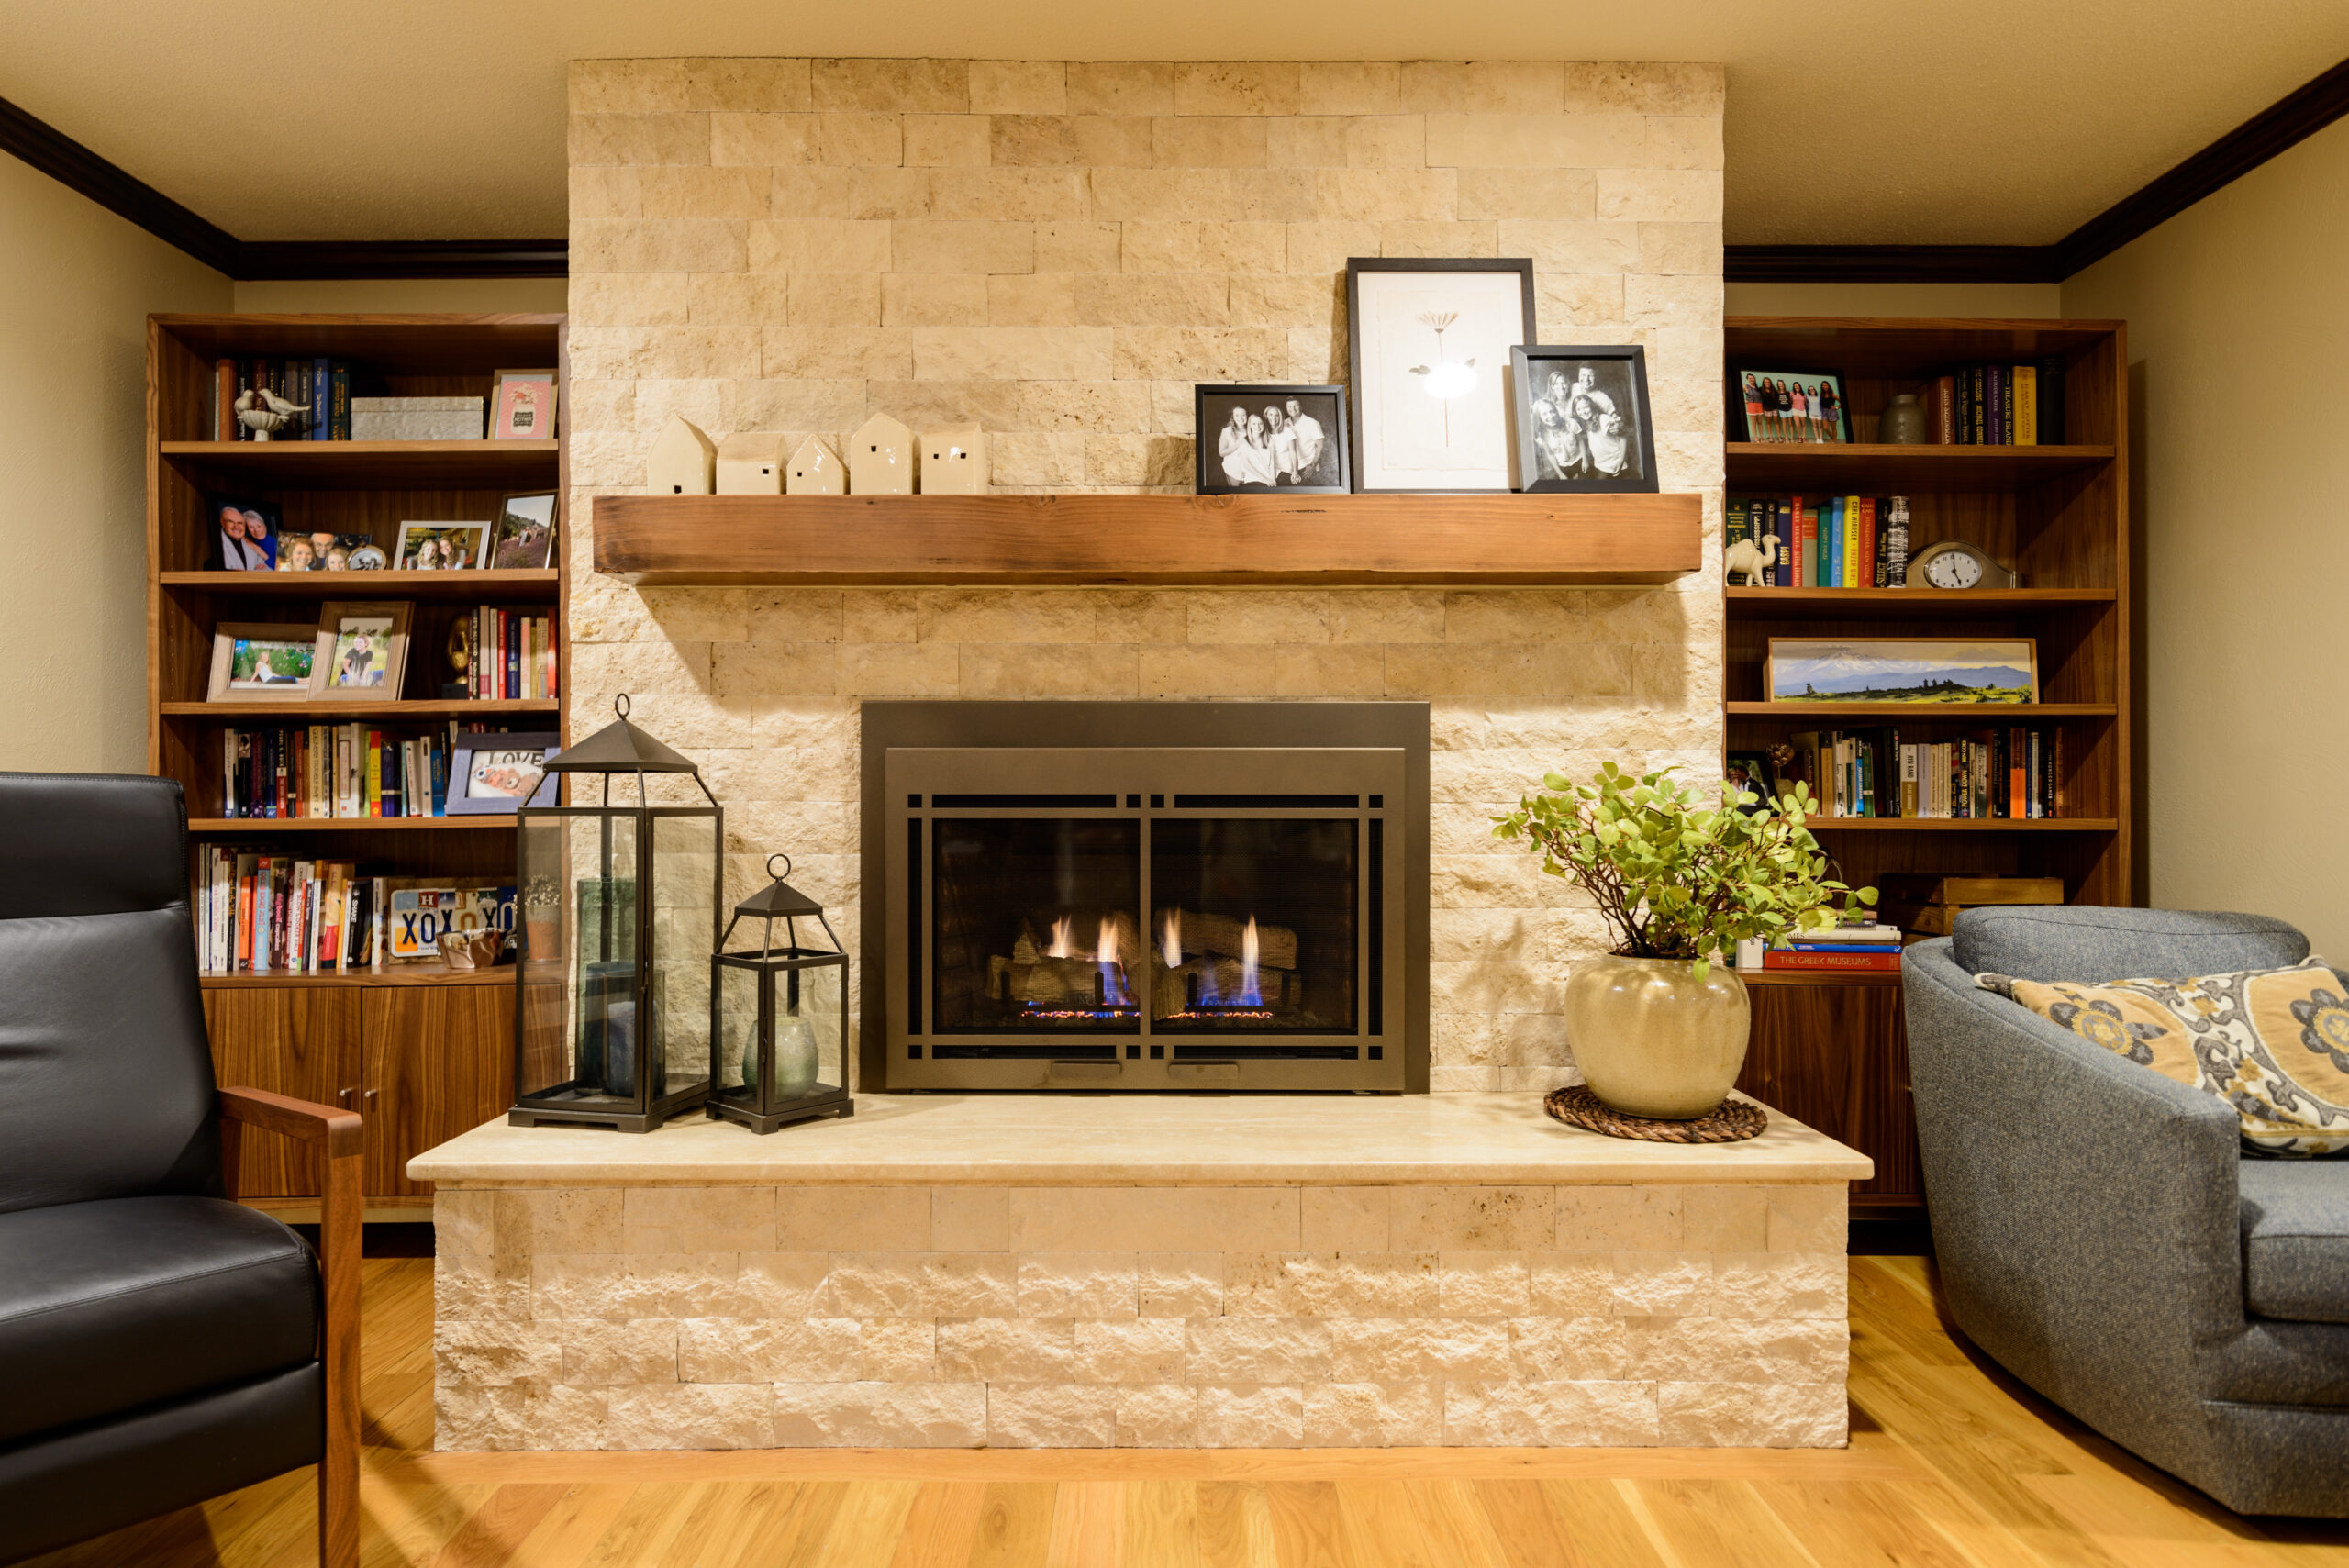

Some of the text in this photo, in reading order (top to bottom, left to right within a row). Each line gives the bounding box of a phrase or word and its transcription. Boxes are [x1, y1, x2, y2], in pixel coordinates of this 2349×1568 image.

[1896, 526, 1905, 573] SPRINGSTEEN
[1876, 562, 1887, 584] SELECT
[489, 751, 543, 768] LOVE
[420, 895, 434, 906] H
[1780, 955, 1872, 966] THE GREEK MUSEUMS
